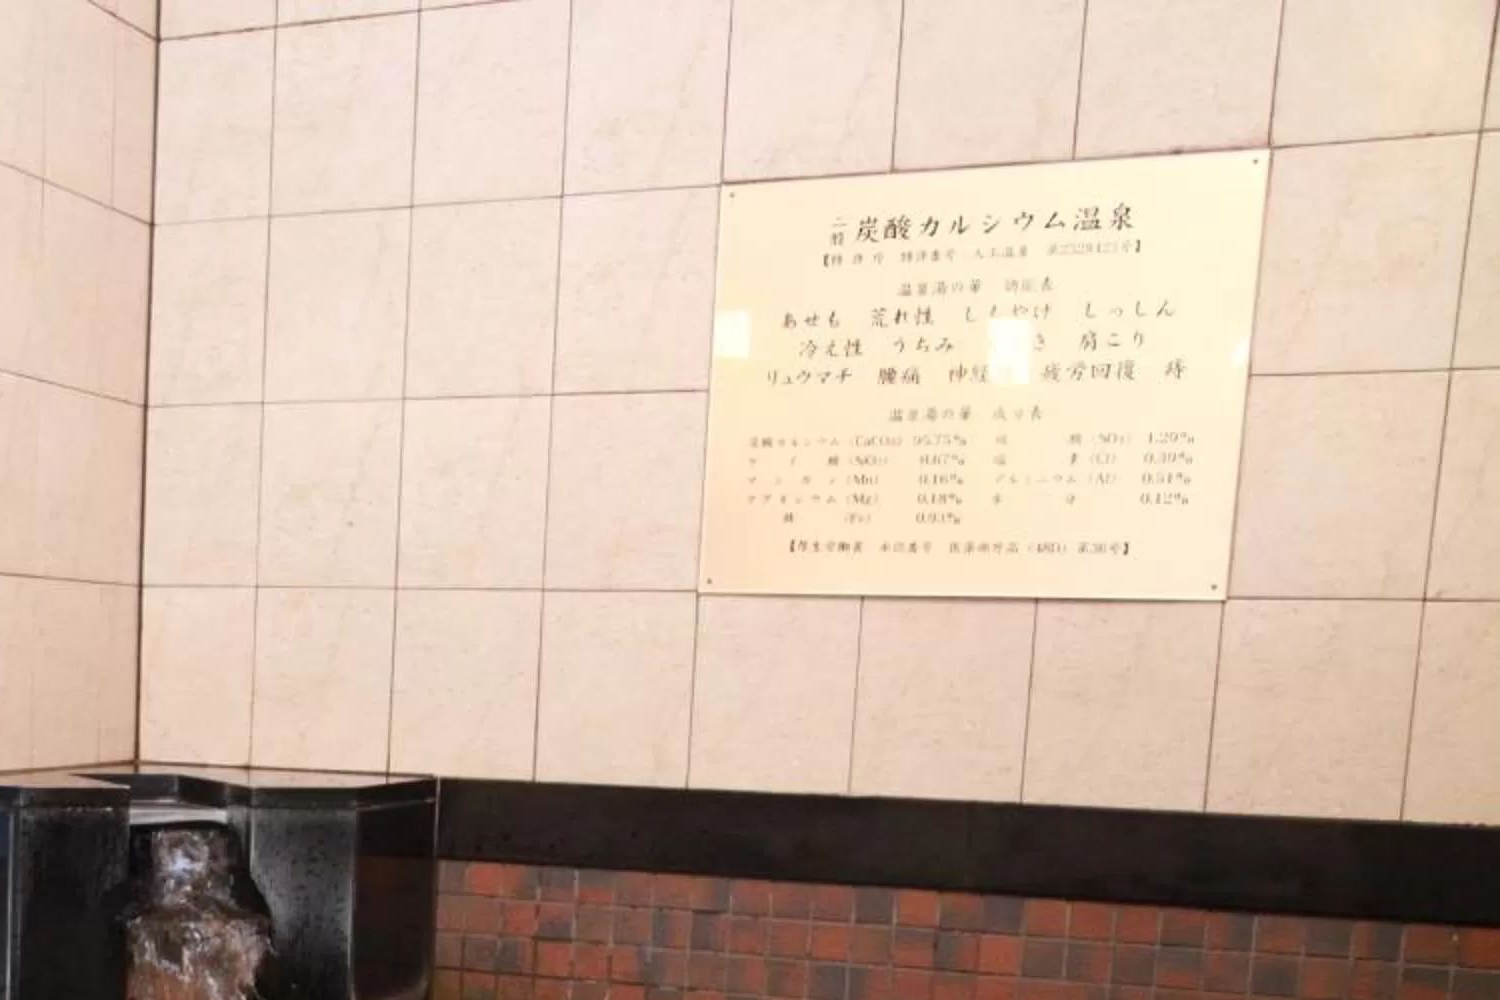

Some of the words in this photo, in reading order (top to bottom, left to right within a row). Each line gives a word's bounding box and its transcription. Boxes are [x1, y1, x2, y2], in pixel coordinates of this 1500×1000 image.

[855, 203, 1135, 243] 炭酸カルシウム温泉
[781, 307, 841, 331] あせも
[869, 303, 936, 329] 荒れ性
[1084, 297, 1177, 320] しっしん
[798, 334, 865, 362] 冷え性
[892, 335, 956, 355] うちみ
[1078, 328, 1146, 354] 肩こり
[766, 363, 853, 388] リュウマチ
